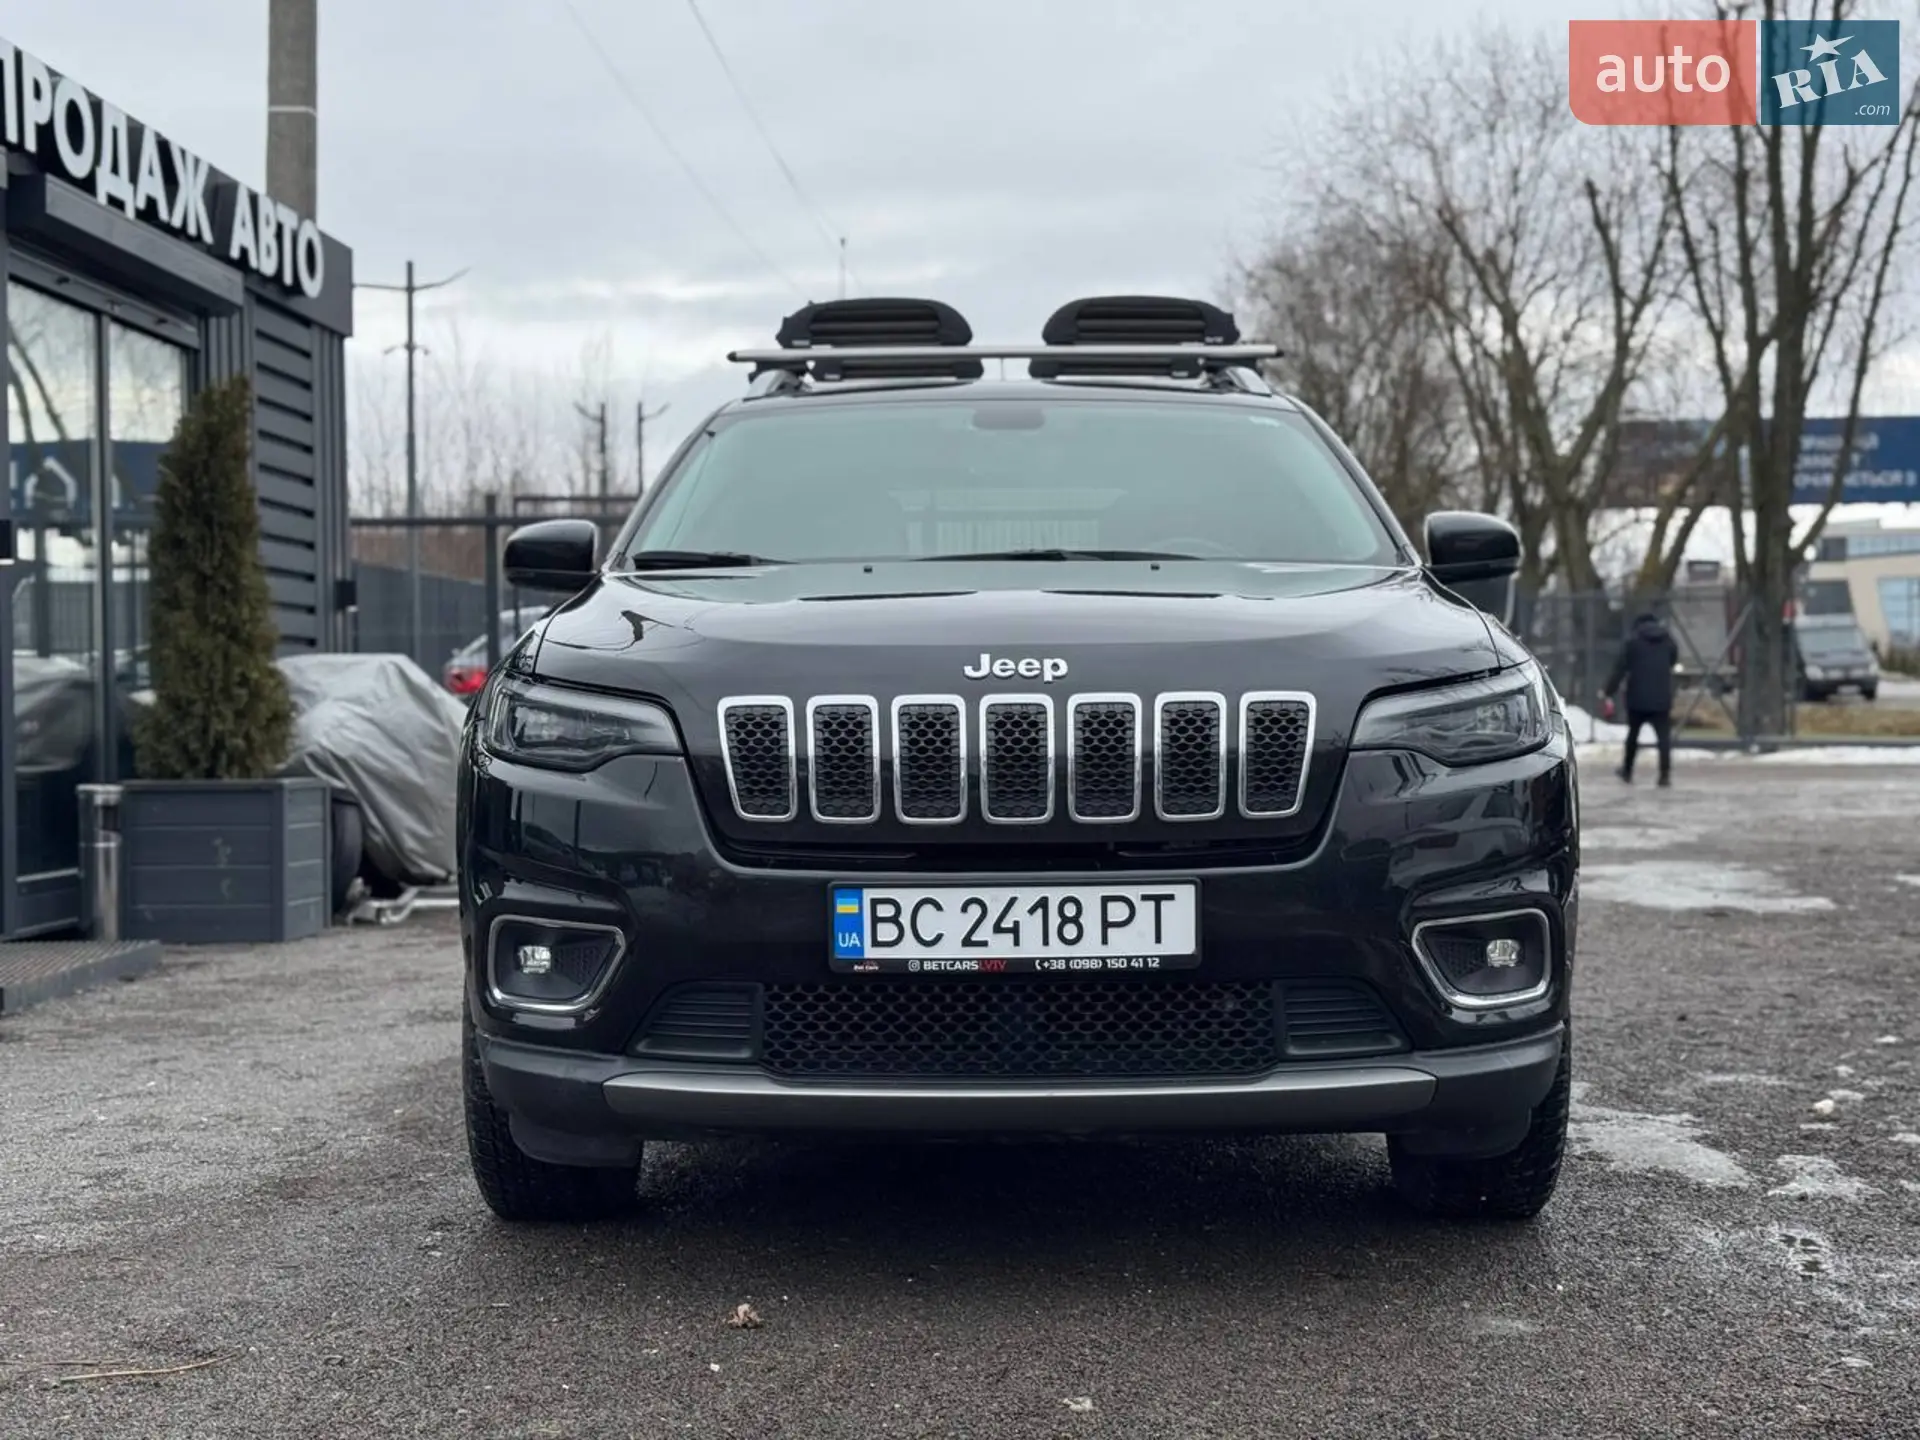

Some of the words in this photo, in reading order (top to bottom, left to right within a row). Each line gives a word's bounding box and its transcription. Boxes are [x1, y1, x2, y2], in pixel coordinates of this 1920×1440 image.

[230, 181, 324, 299] АВТО
[963, 653, 1069, 684] Jeep
[869, 896, 944, 948] BC
[960, 895, 1084, 947] 2418
[1100, 893, 1176, 946] PT
[838, 932, 862, 948] UA
[1069, 958, 1103, 970] (098)
[1105, 957, 1128, 969] 150
[1130, 957, 1144, 968] 41
[1146, 957, 1161, 968] 12
